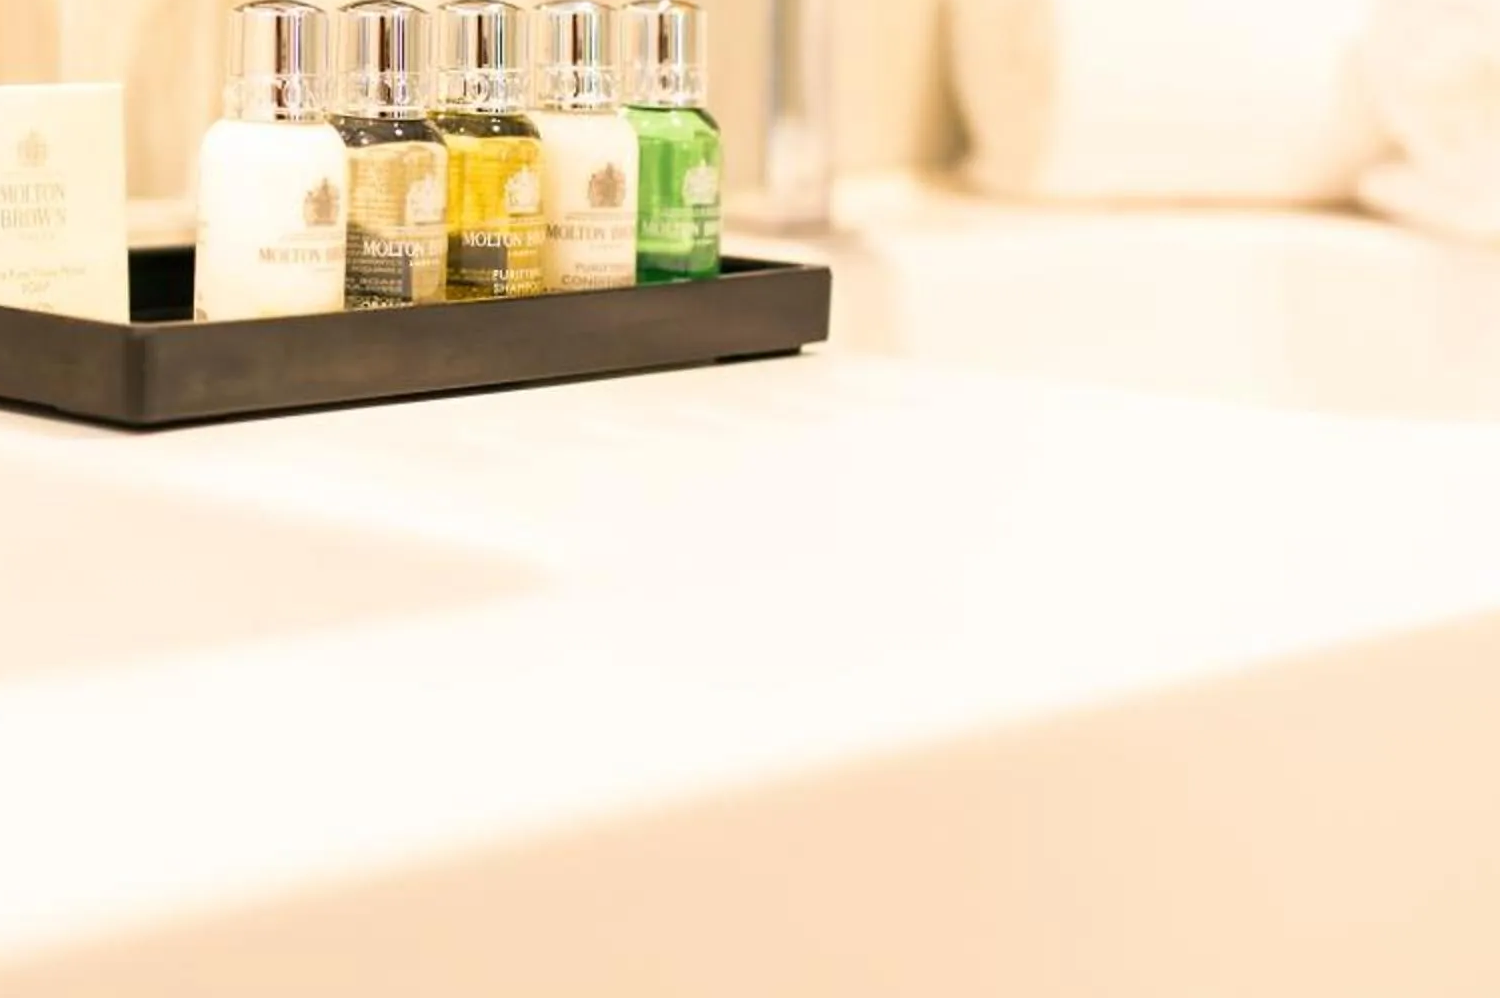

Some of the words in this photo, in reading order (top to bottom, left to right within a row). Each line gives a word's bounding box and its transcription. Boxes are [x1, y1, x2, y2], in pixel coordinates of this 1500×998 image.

[0, 207, 67, 230] BROWN
[461, 230, 522, 248] MOLTON
[545, 223, 605, 241] MOLTON
[258, 246, 323, 266] MOLTON
[362, 240, 425, 258] MOLTON
